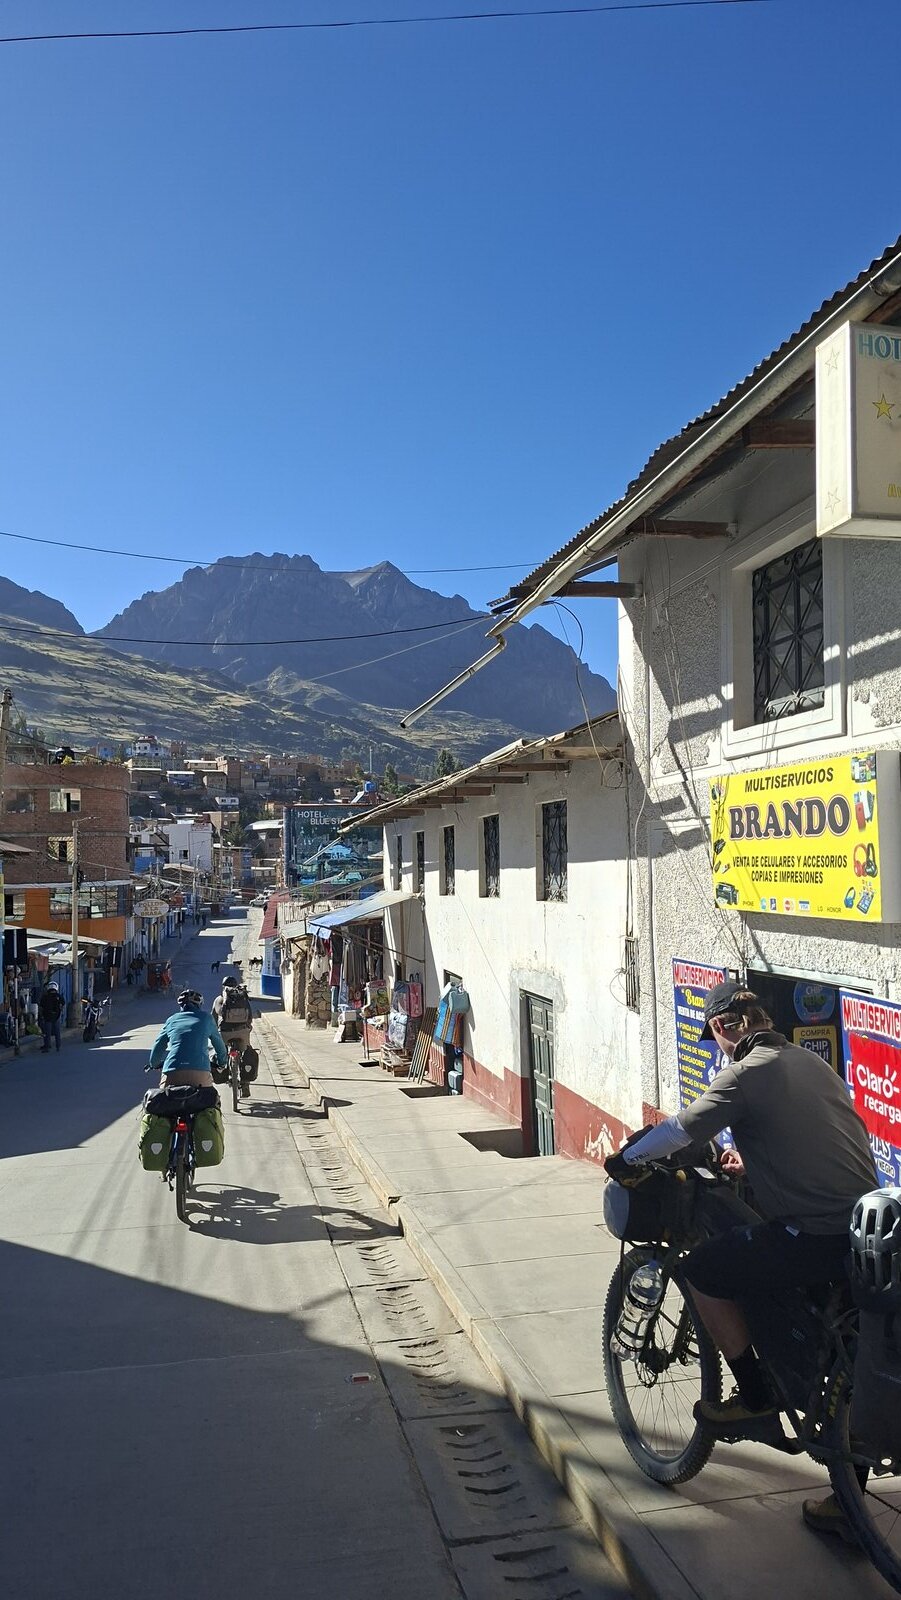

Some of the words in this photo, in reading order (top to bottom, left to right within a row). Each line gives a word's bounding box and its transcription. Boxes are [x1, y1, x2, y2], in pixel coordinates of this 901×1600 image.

[744, 768, 834, 793] MULTISERVICIOS
[729, 795, 851, 840] BRANDO
[732, 856, 750, 867] VENTA
[751, 856, 760, 867] DE
[760, 856, 795, 868] CELULARES
[797, 856, 803, 868] Y
[803, 855, 848, 868] ACCESORIOS
[751, 871, 772, 882] COPIAS
[774, 872, 779, 882] E
[780, 872, 823, 884] IMPRESIONES
[696, 1011, 705, 1022] ACC
[800, 1029, 831, 1037] COMPRA
[804, 1040, 828, 1051] CHIP
[855, 1063, 895, 1099] Claro
[864, 1094, 901, 1125] recarga
